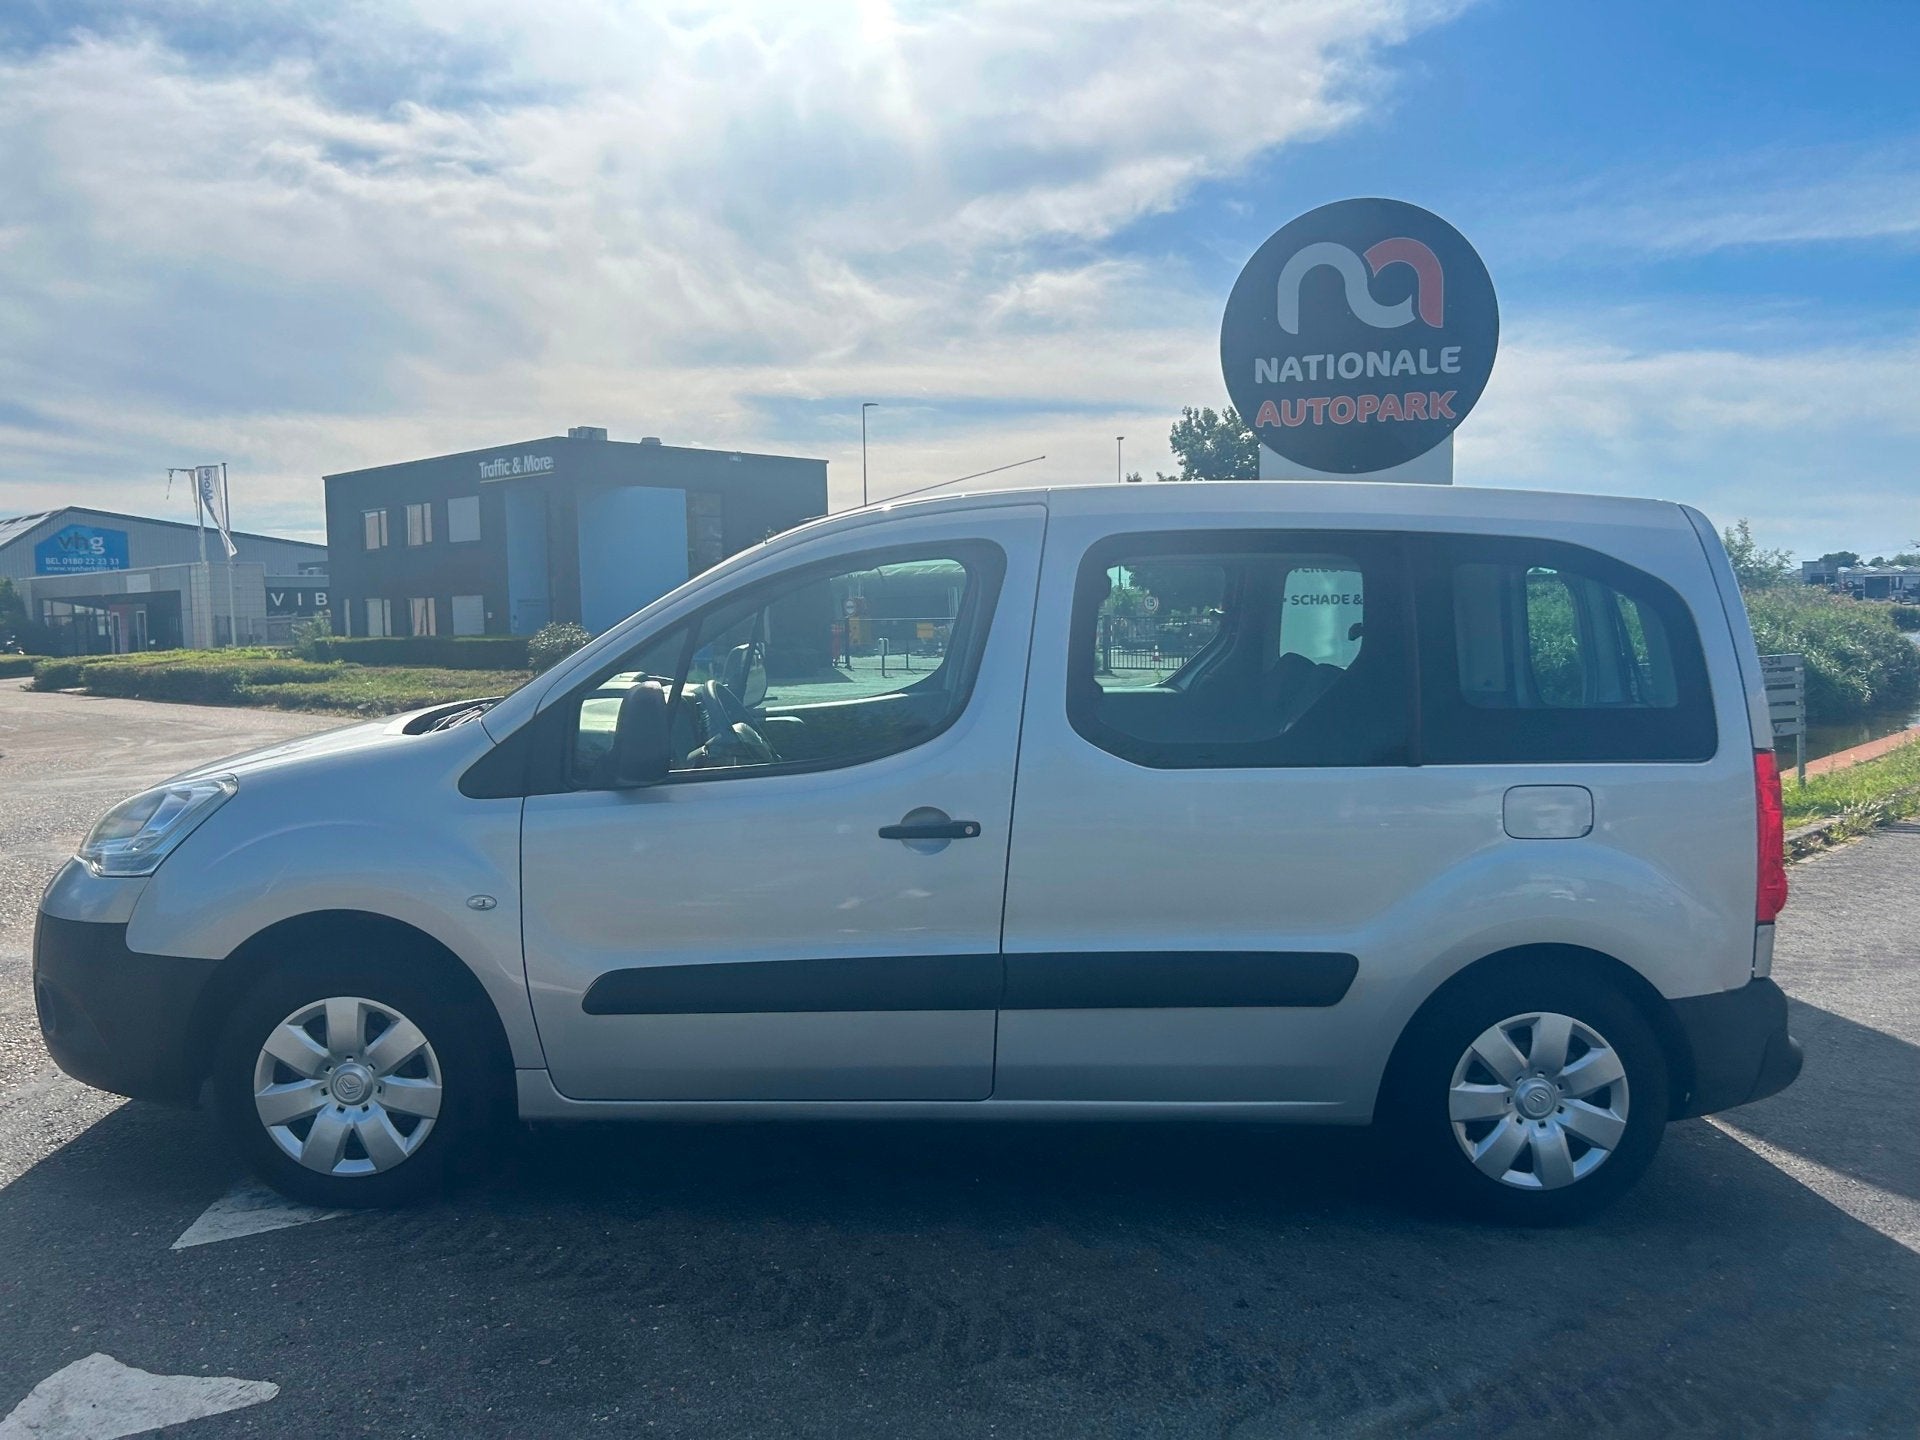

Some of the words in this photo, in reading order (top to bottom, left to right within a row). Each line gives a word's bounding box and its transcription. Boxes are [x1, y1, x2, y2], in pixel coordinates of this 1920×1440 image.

[1254, 346, 1462, 384] NATIONALE
[1254, 390, 1458, 428] AUTOPARK
[479, 458, 511, 479] Traffic
[512, 457, 521, 474] &
[523, 454, 553, 473] More
[45, 557, 61, 565] BEL
[1290, 594, 1350, 606] SCHADE
